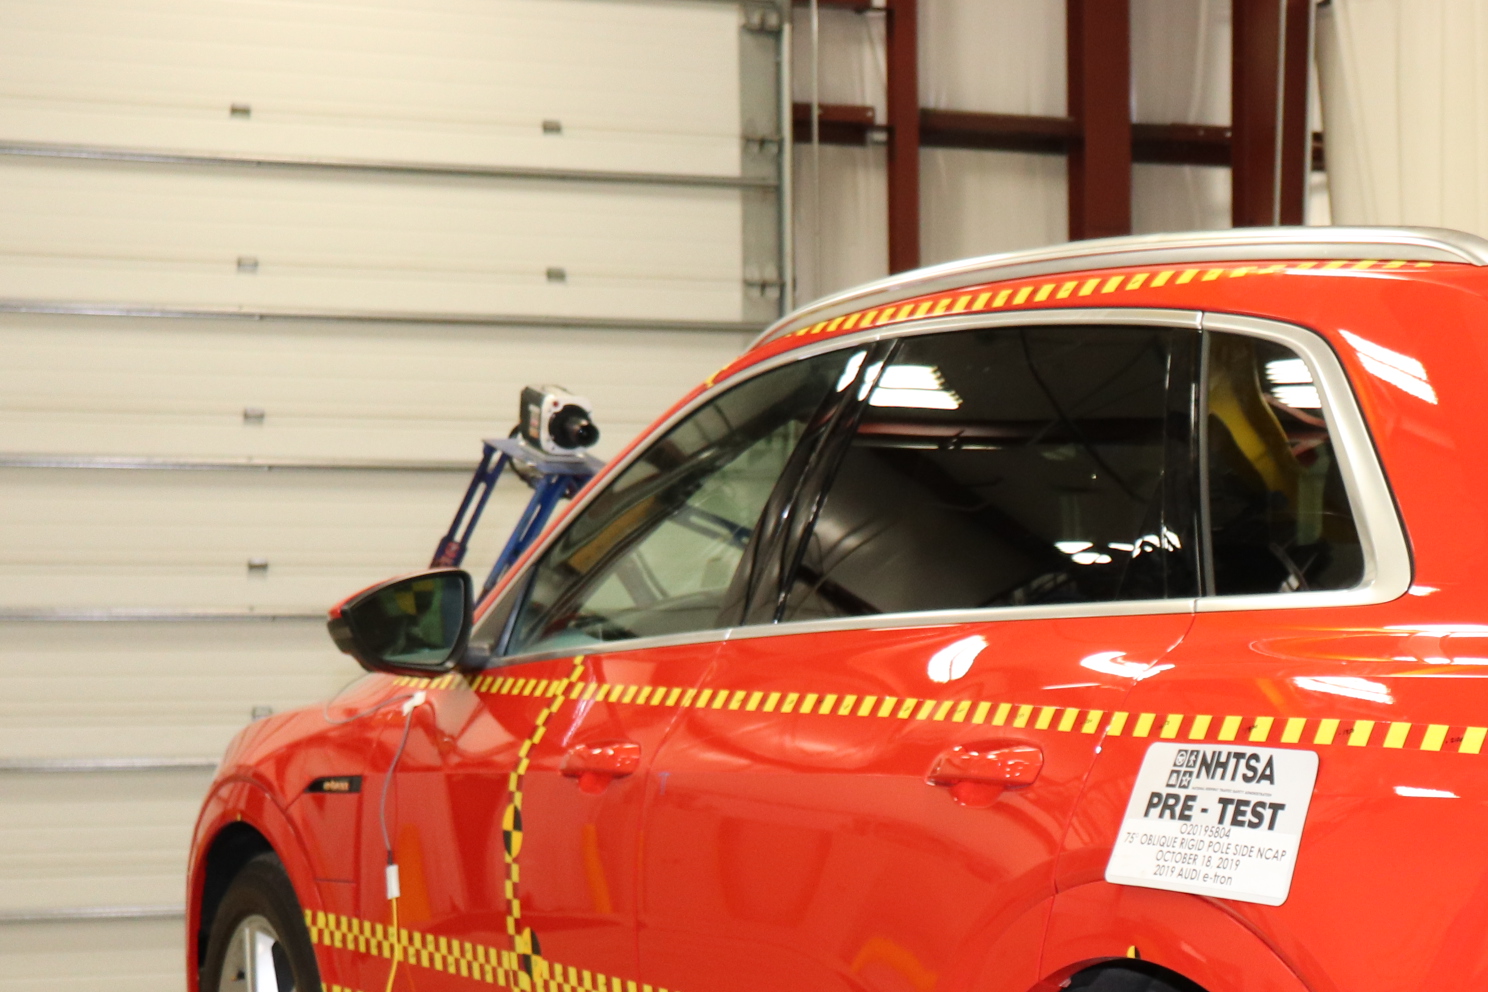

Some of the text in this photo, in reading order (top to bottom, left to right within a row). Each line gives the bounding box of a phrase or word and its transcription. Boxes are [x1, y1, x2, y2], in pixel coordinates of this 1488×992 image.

[1195, 749, 1275, 785] NHTSA
[1143, 791, 1198, 822] PRE
[1217, 797, 1286, 831] TEST
[1139, 833, 1178, 849] OBLIQUE
[1179, 837, 1204, 852] RIGID
[1207, 841, 1231, 856] POLE
[1232, 844, 1255, 858] SIDE
[1256, 847, 1287, 862] NCAP
[1155, 850, 1241, 871] OCTOBER 18, 2019
[1153, 864, 1233, 886] 2019 AUDI e-tron
